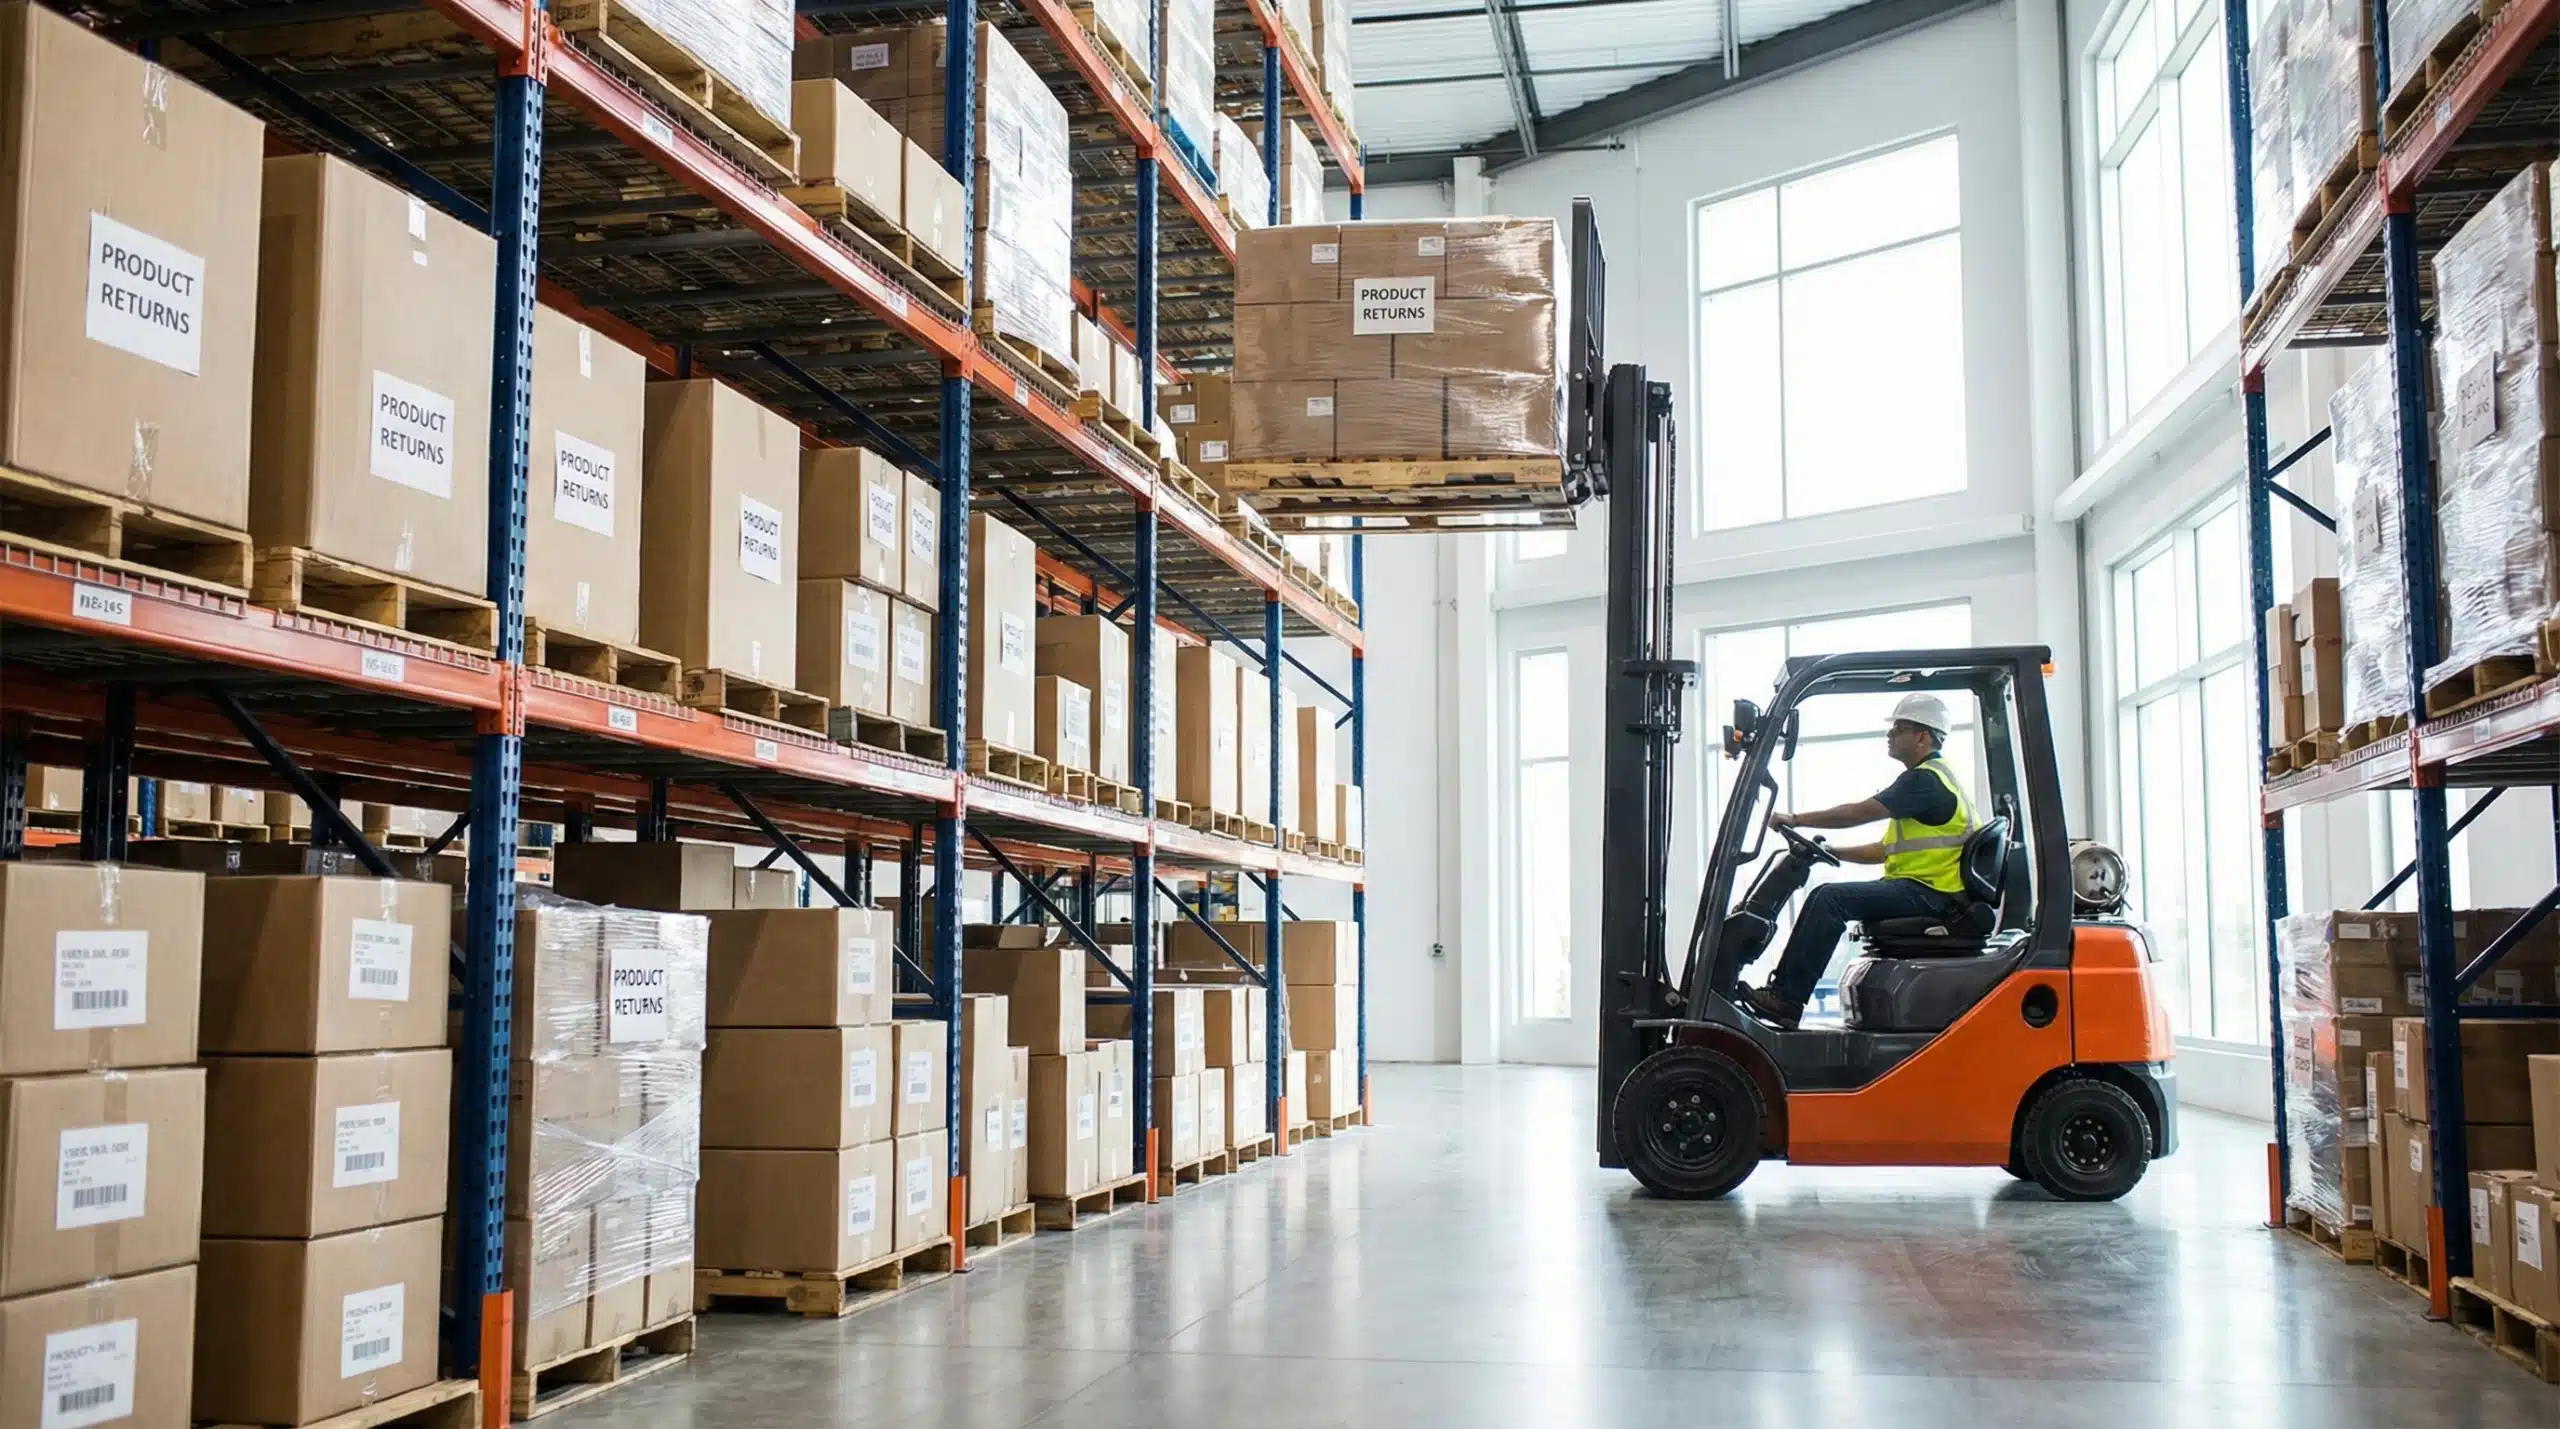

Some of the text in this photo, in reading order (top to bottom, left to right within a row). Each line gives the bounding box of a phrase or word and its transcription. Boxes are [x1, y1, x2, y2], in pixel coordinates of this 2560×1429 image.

[102, 242, 195, 297] PRODUCT
[101, 282, 190, 335] RETURNS
[1361, 287, 1427, 301] PRODUCT
[1363, 306, 1426, 320] RETURNS
[380, 393, 447, 433] PRODUCT
[380, 427, 445, 465] RETURNS
[561, 449, 611, 482] PRODUCT
[562, 479, 609, 510] RETURNS
[614, 968, 665, 987] PRODUCT
[614, 996, 664, 1016] RETURNS
